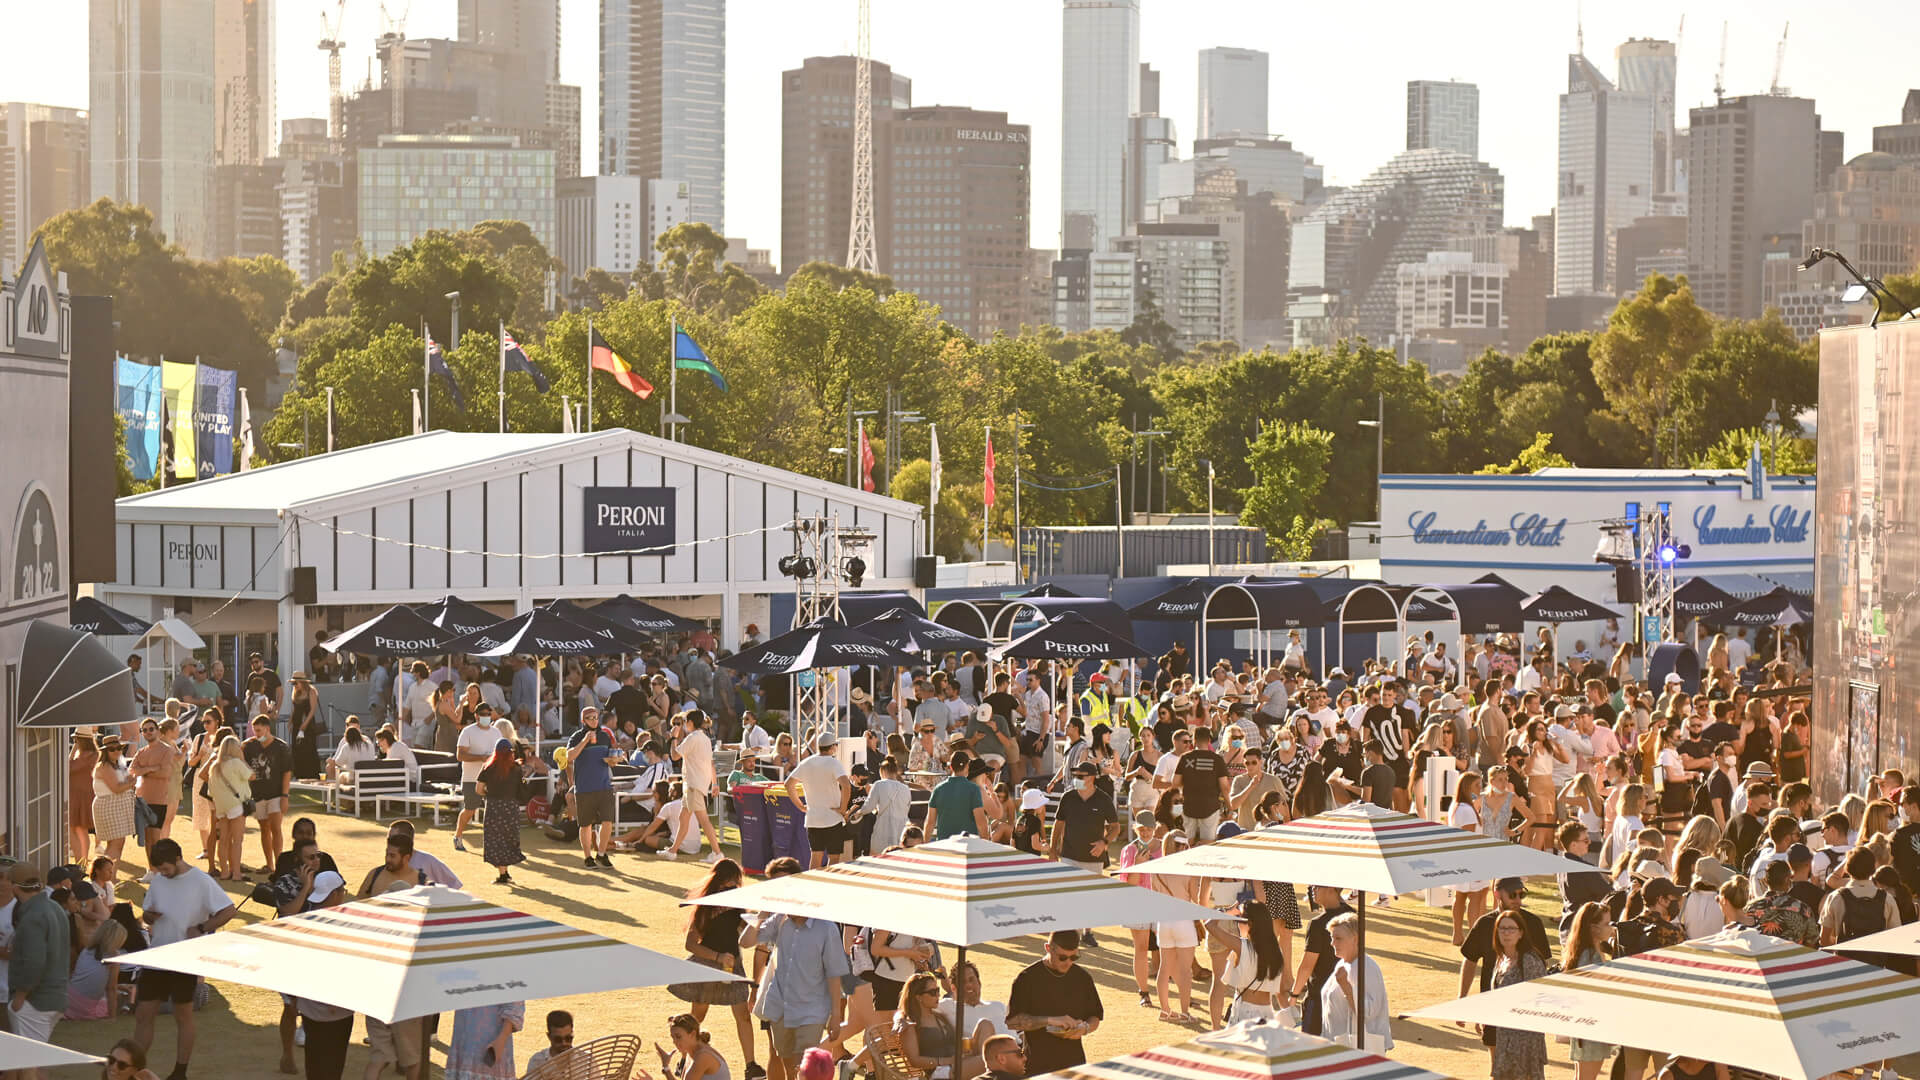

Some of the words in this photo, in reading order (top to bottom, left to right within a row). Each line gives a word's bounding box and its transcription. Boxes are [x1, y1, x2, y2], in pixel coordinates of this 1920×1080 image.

[957, 129, 1003, 142] HERALD
[1007, 132, 1028, 144] SUN
[27, 284, 49, 335] AO
[208, 424, 231, 435] PLAY
[597, 503, 666, 526] PERONI
[1408, 510, 1512, 545] Canadian
[1510, 512, 1568, 546] Club
[1693, 504, 1772, 544] Canadian
[1769, 504, 1811, 544] Club
[168, 541, 218, 561] PERONI
[1157, 602, 1199, 611] PERONI
[1676, 600, 1724, 611] PERONI
[1538, 608, 1589, 618] PERONI
[1734, 611, 1784, 622] PERONI
[631, 617, 675, 627] PERONI
[375, 635, 437, 649] PERONI
[535, 637, 595, 649] PERONI
[1044, 640, 1111, 653] PERONI
[832, 643, 889, 657] PERONI
[1509, 1006, 1573, 1022] squealing
[1574, 1016, 1600, 1026] pig
